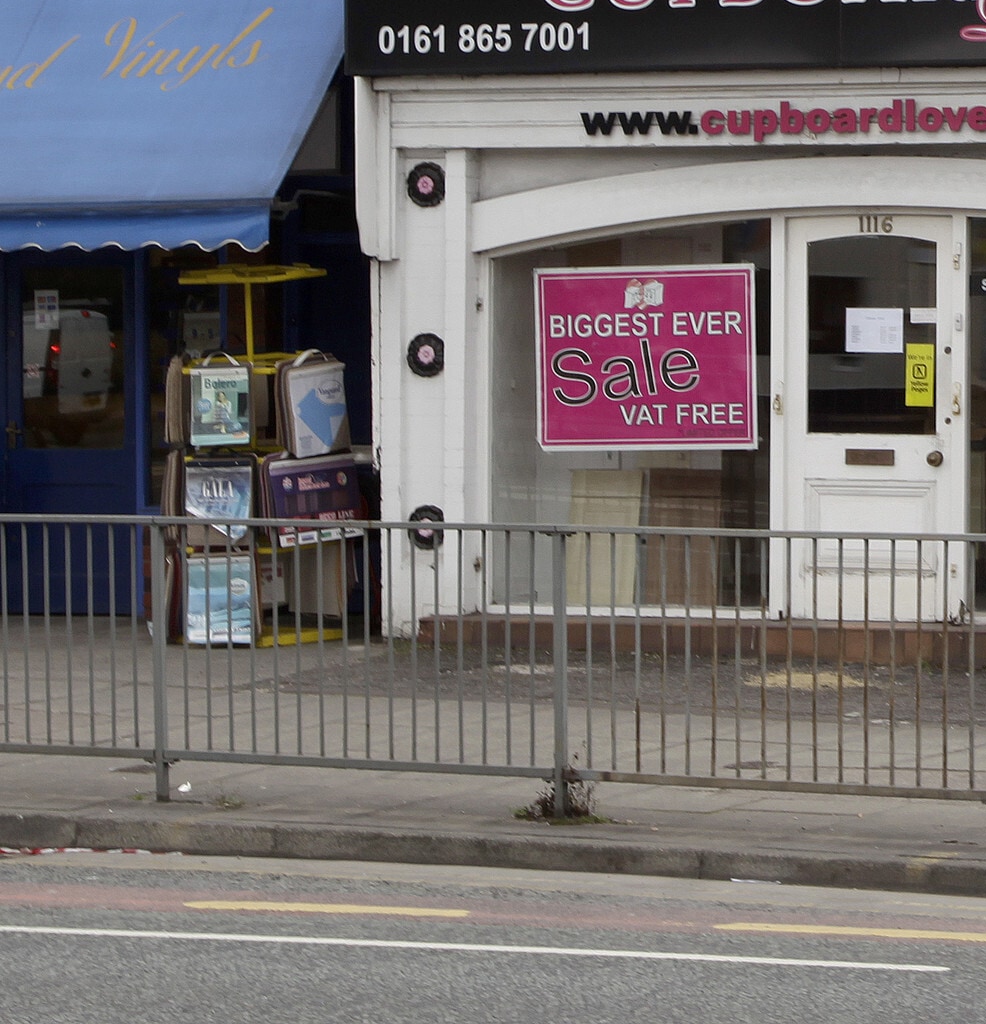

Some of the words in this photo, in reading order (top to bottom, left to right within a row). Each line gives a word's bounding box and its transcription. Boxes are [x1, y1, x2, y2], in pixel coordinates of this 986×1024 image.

[100, 6, 275, 92] Vinyls
[378, 24, 446, 54] 0161
[458, 22, 512, 53] 865
[521, 21, 590, 51] 7001
[858, 215, 893, 233] 1116
[550, 312, 664, 338] BIGGEST
[672, 310, 743, 336] EVER
[551, 338, 700, 407] Sale
[619, 404, 668, 426] VAT
[676, 403, 745, 425] FREE
